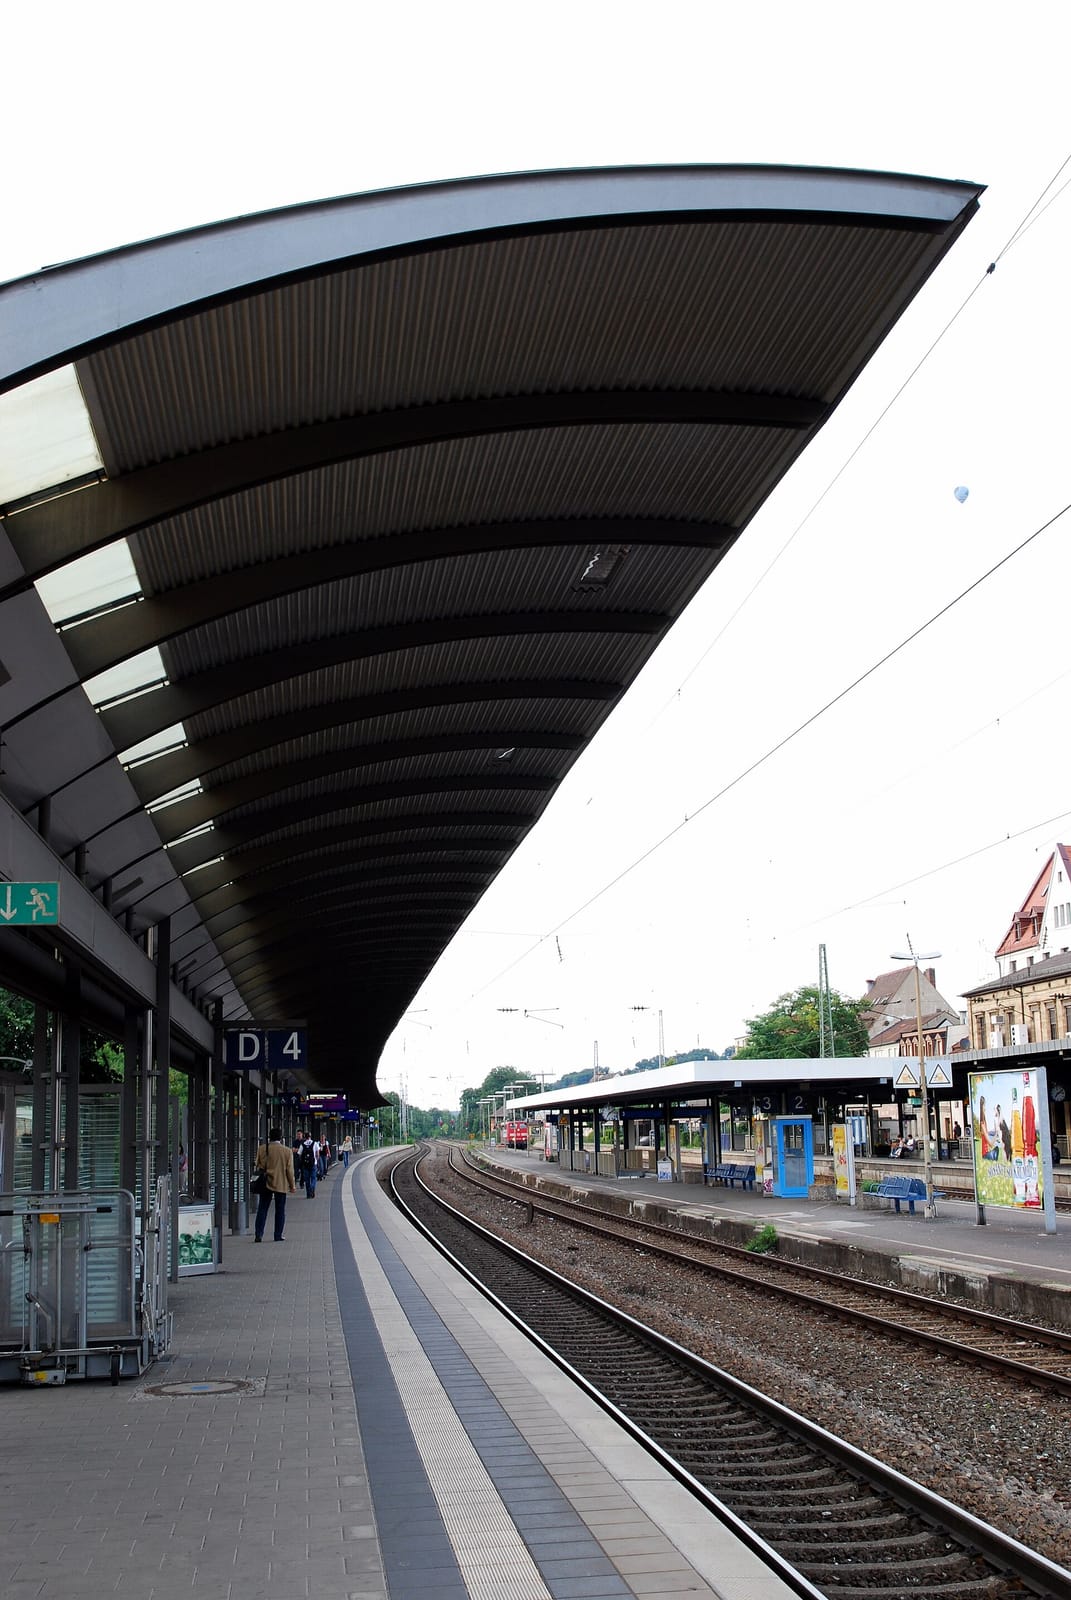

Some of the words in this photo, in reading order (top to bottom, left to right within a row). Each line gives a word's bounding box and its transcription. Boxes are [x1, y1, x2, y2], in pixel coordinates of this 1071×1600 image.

[239, 1033, 260, 1061] D
[282, 1032, 302, 1060] 4
[763, 1096, 772, 1110] 3
[794, 1095, 804, 1109] 2
